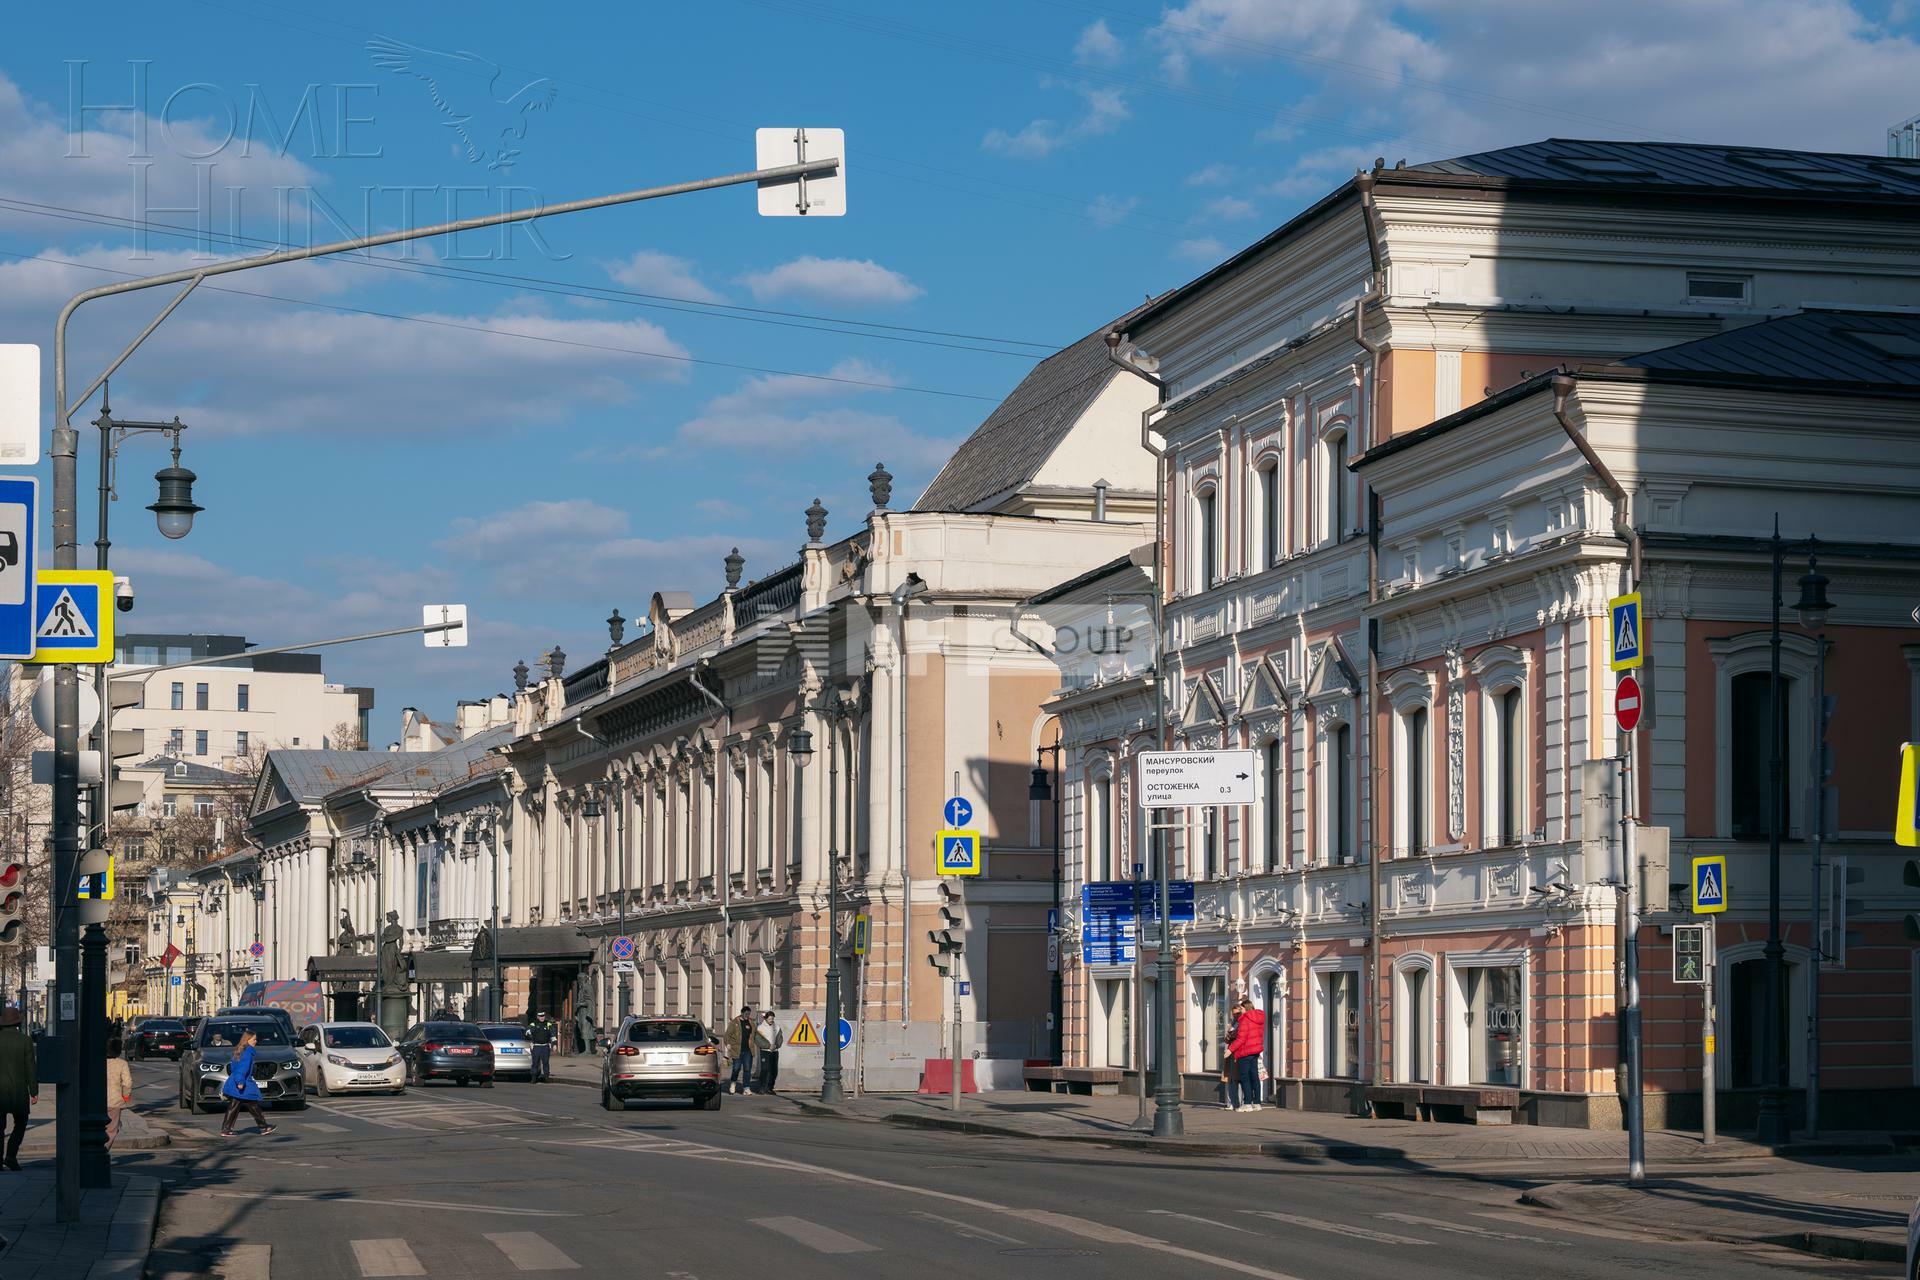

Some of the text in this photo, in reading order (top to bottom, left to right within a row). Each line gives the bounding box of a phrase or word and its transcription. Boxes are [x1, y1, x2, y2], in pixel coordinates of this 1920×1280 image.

[1145, 756, 1215, 765] МАНСУРОВСКИЙ
[1147, 783, 1200, 791] ОСТОЖЕНКА
[1219, 786, 1232, 794] 0.3
[1147, 793, 1172, 801] улица
